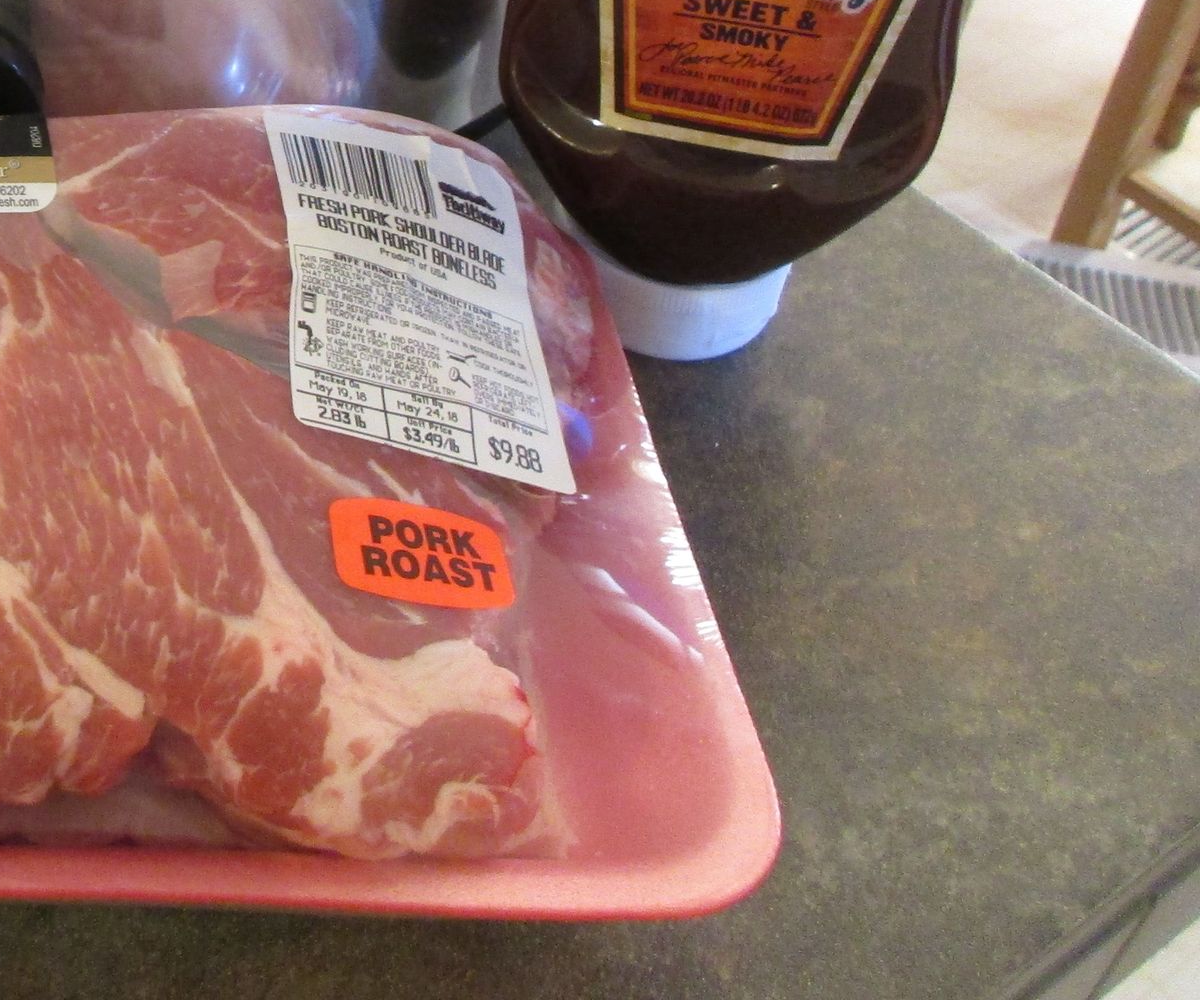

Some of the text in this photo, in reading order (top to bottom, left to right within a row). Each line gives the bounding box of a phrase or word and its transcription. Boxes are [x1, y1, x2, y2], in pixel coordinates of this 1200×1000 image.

[796, 10, 817, 31] &
[700, 22, 789, 52] SMOKY
[639, 81, 659, 98] NET
[662, 84, 680, 100] WT
[298, 193, 347, 217] FRESH
[351, 205, 393, 229] PORK
[394, 216, 465, 254] SHOULDER
[467, 241, 506, 276] BLADE
[316, 213, 380, 245] BOSTON
[382, 230, 429, 260] ROAST
[432, 247, 498, 290] BONELESS
[380, 247, 448, 281] Product of USA
[421, 282, 493, 319] INSTRUCTIONS
[309, 380, 332, 397] May
[356, 391, 367, 402] 18
[314, 371, 346, 386] Packed
[318, 405, 367, 429] 2.83 lb
[397, 400, 419, 416] May
[448, 411, 459, 423] 18
[403, 426, 460, 453] $3.49/lb
[488, 416, 533, 437] Total Price
[488, 436, 543, 474] $9.88
[368, 514, 482, 560] PORK
[361, 544, 496, 592] ROAST
